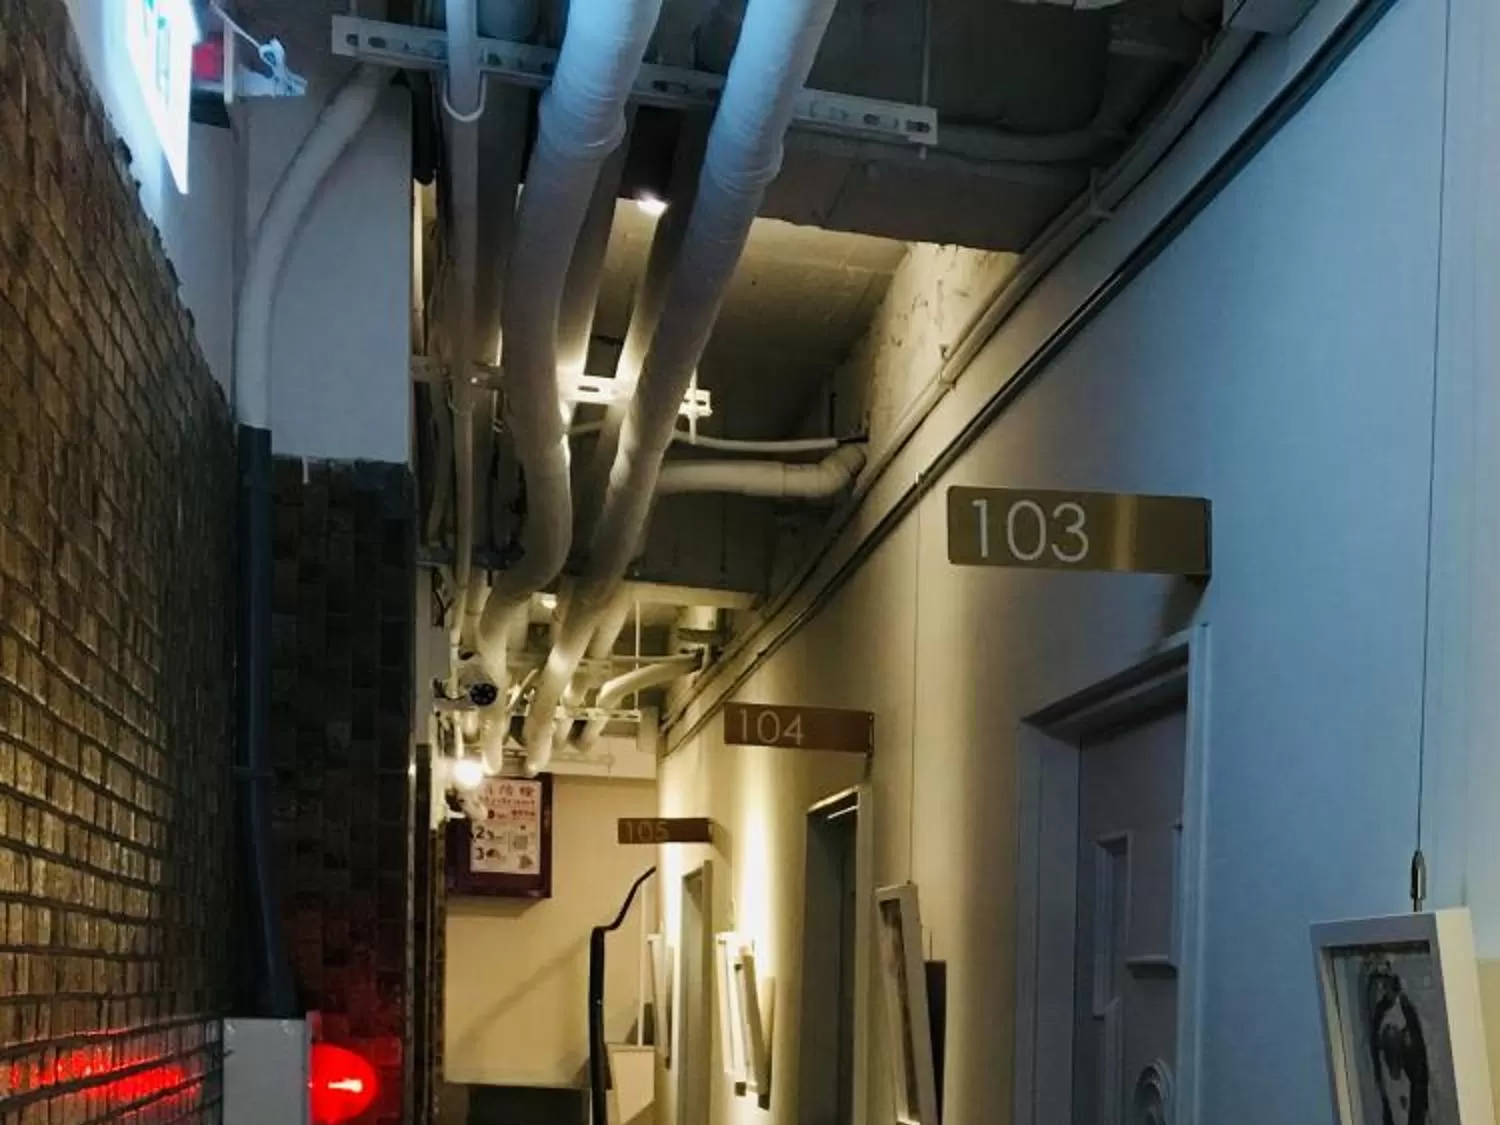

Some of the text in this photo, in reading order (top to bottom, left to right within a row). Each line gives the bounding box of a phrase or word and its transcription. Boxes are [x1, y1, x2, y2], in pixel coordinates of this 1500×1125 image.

[972, 499, 1089, 562] 103
[739, 707, 804, 746] 104
[626, 820, 670, 842] 105
